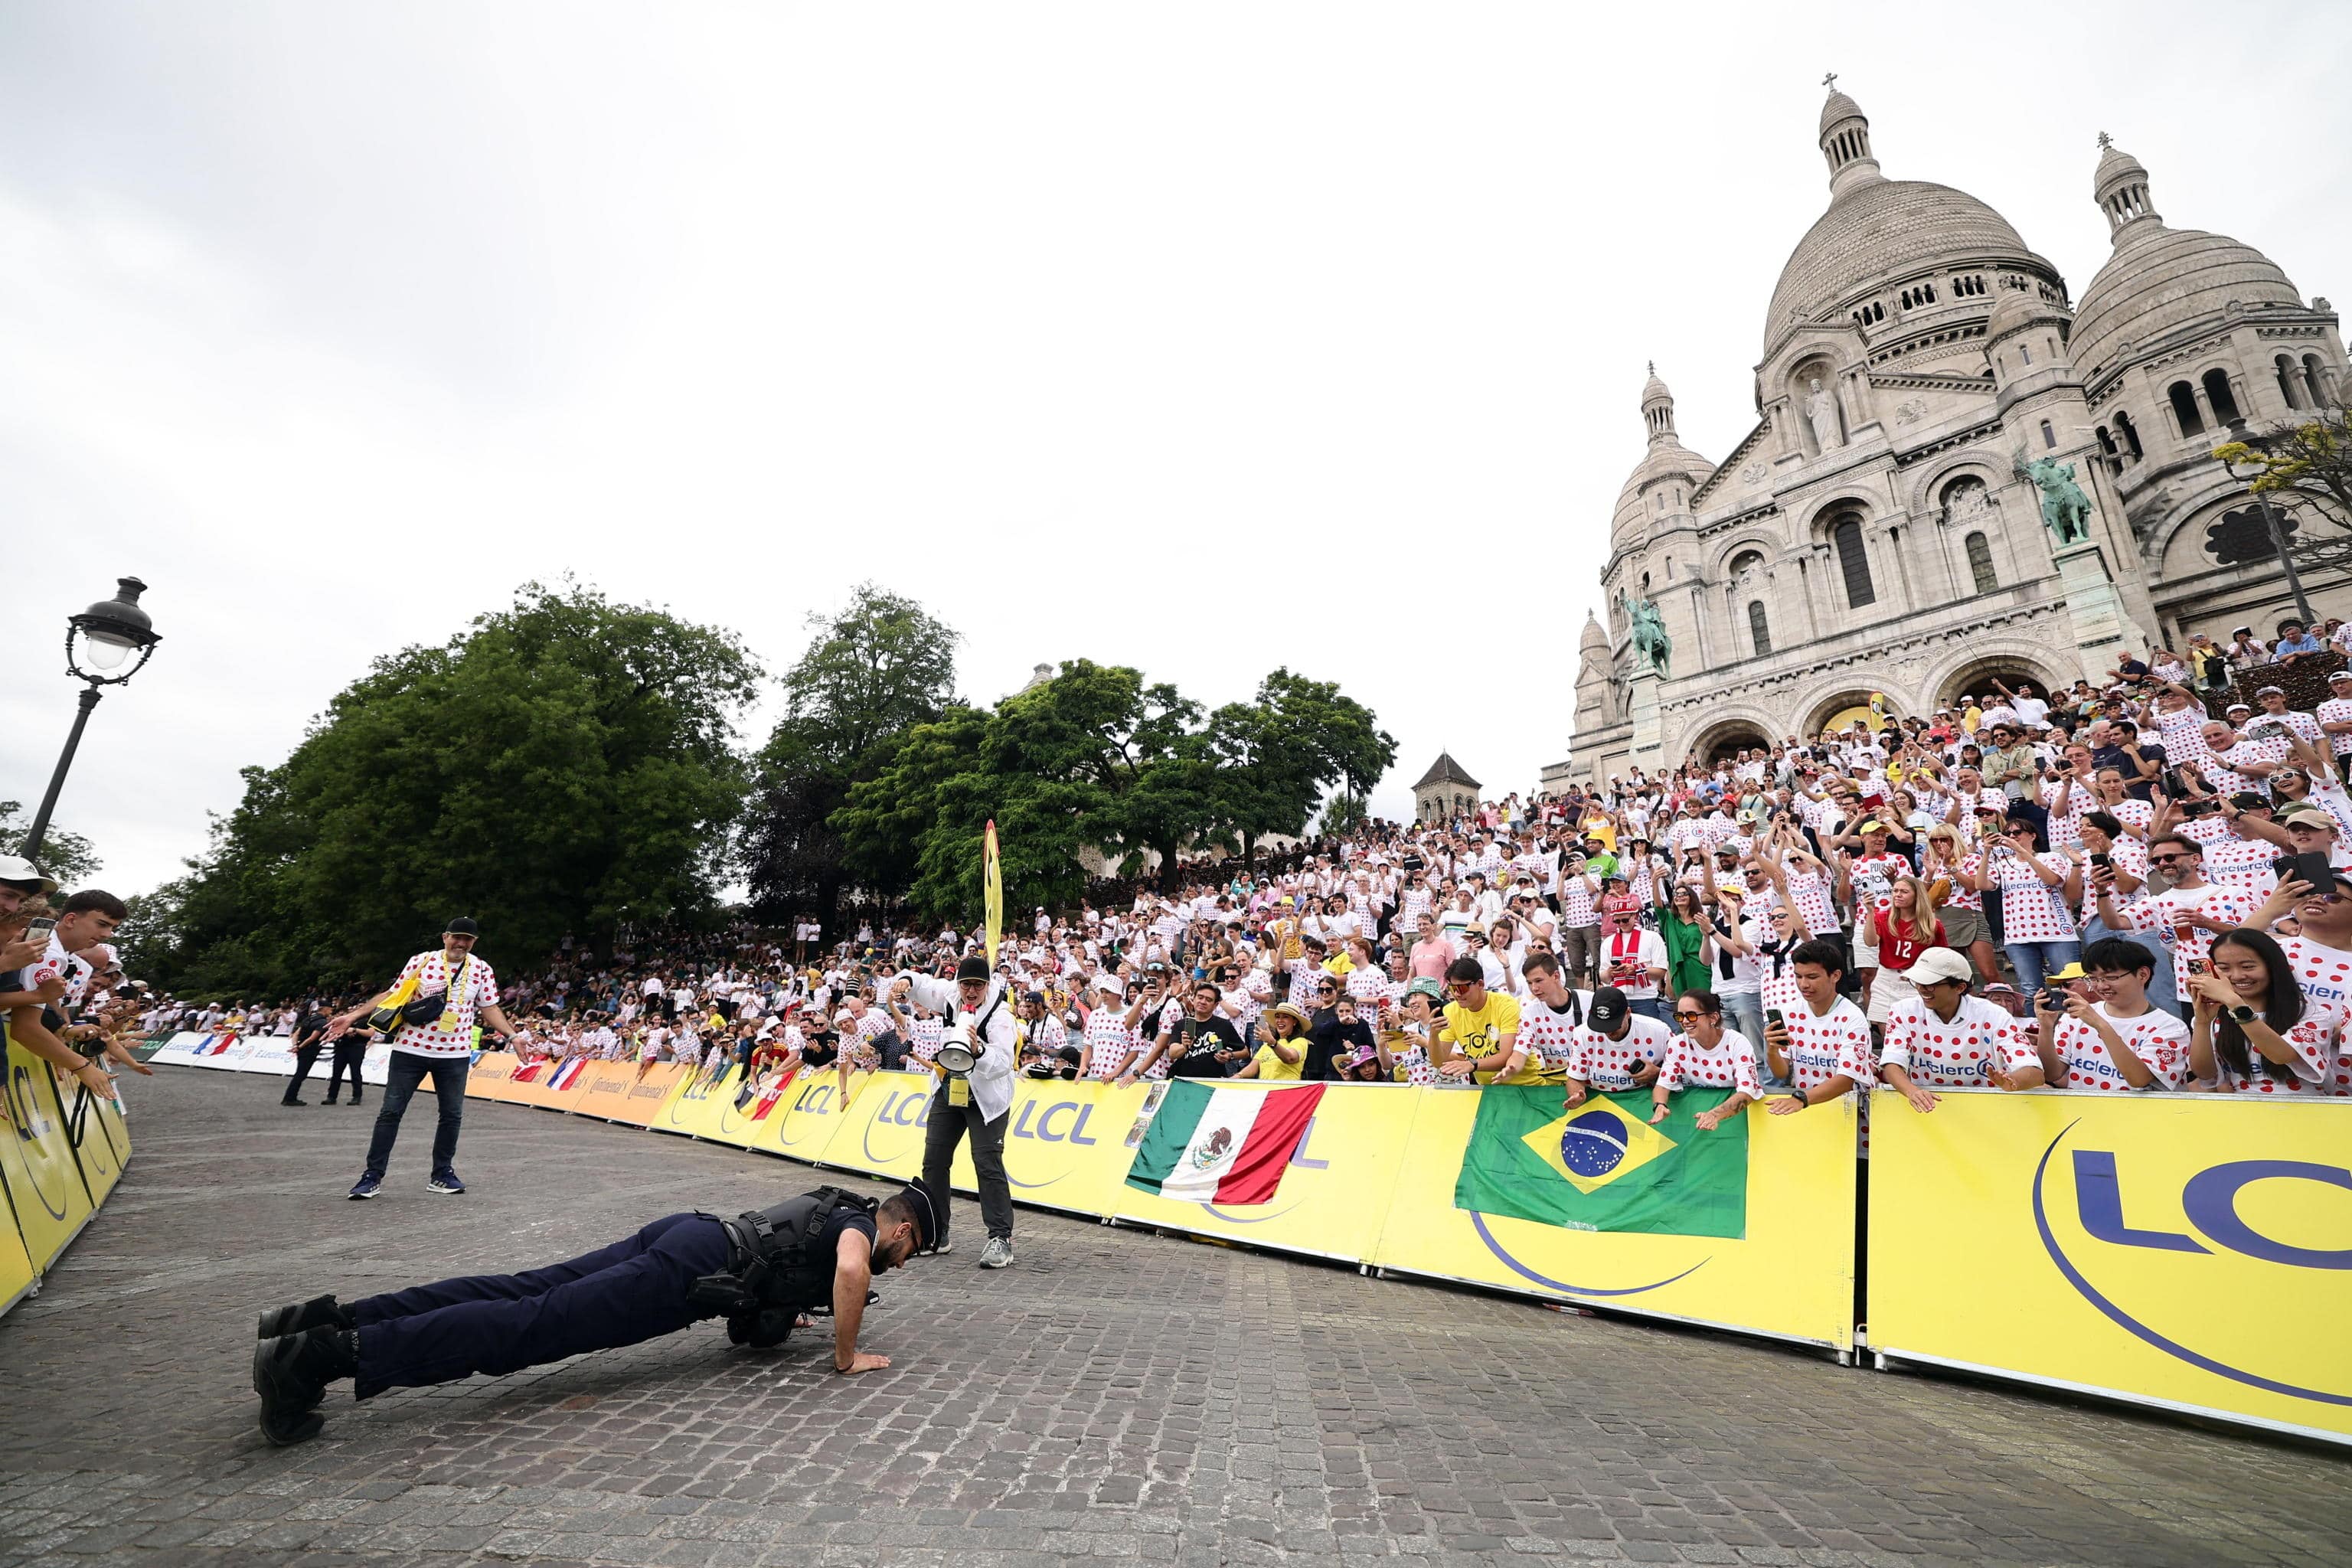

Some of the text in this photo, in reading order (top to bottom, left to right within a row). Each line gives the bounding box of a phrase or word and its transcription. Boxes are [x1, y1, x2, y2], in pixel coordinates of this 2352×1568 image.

[2052, 890, 2068, 923] Leclerc
[1895, 940, 1913, 959] 12
[794, 1084, 836, 1116] LCL
[1013, 1099, 1096, 1146] LCL
[2072, 1149, 2352, 1270] LC
